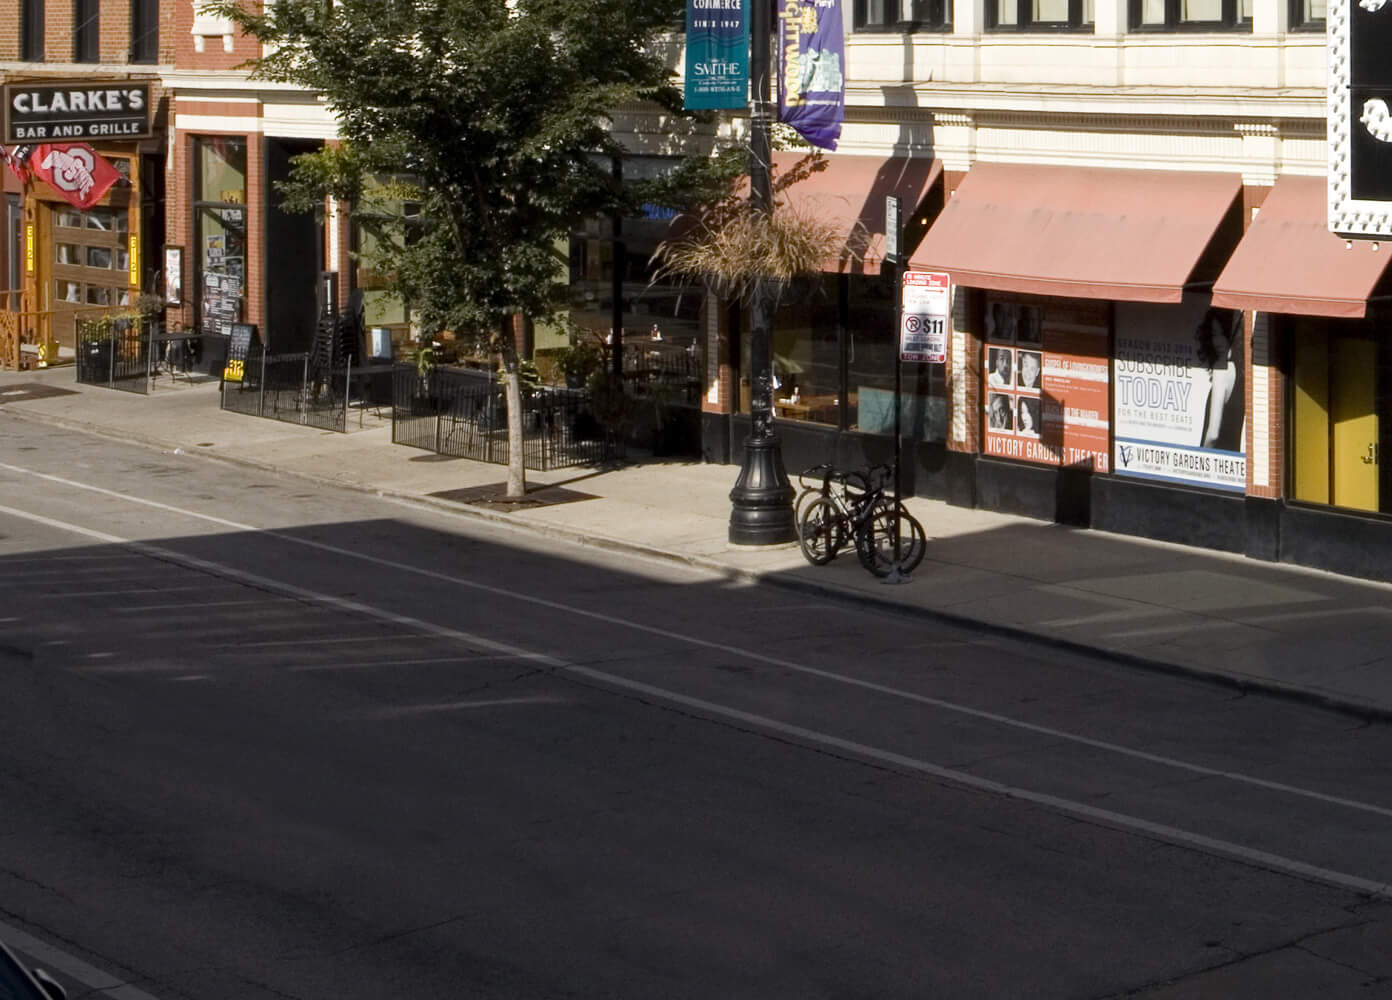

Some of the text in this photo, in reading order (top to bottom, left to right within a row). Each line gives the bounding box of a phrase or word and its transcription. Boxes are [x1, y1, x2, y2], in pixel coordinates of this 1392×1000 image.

[13, 89, 144, 113] CLARKE'S
[16, 123, 140, 138] BAR AND GRILLE
[1118, 352, 1192, 378] SUBSCRIBE
[1119, 375, 1192, 412] TODAY
[988, 436, 1108, 471] VICTORY GARDENS THEATER
[1137, 448, 1170, 466] VICTORY
[1173, 453, 1210, 471] GARDENS
[1213, 458, 1245, 476] THEATE
